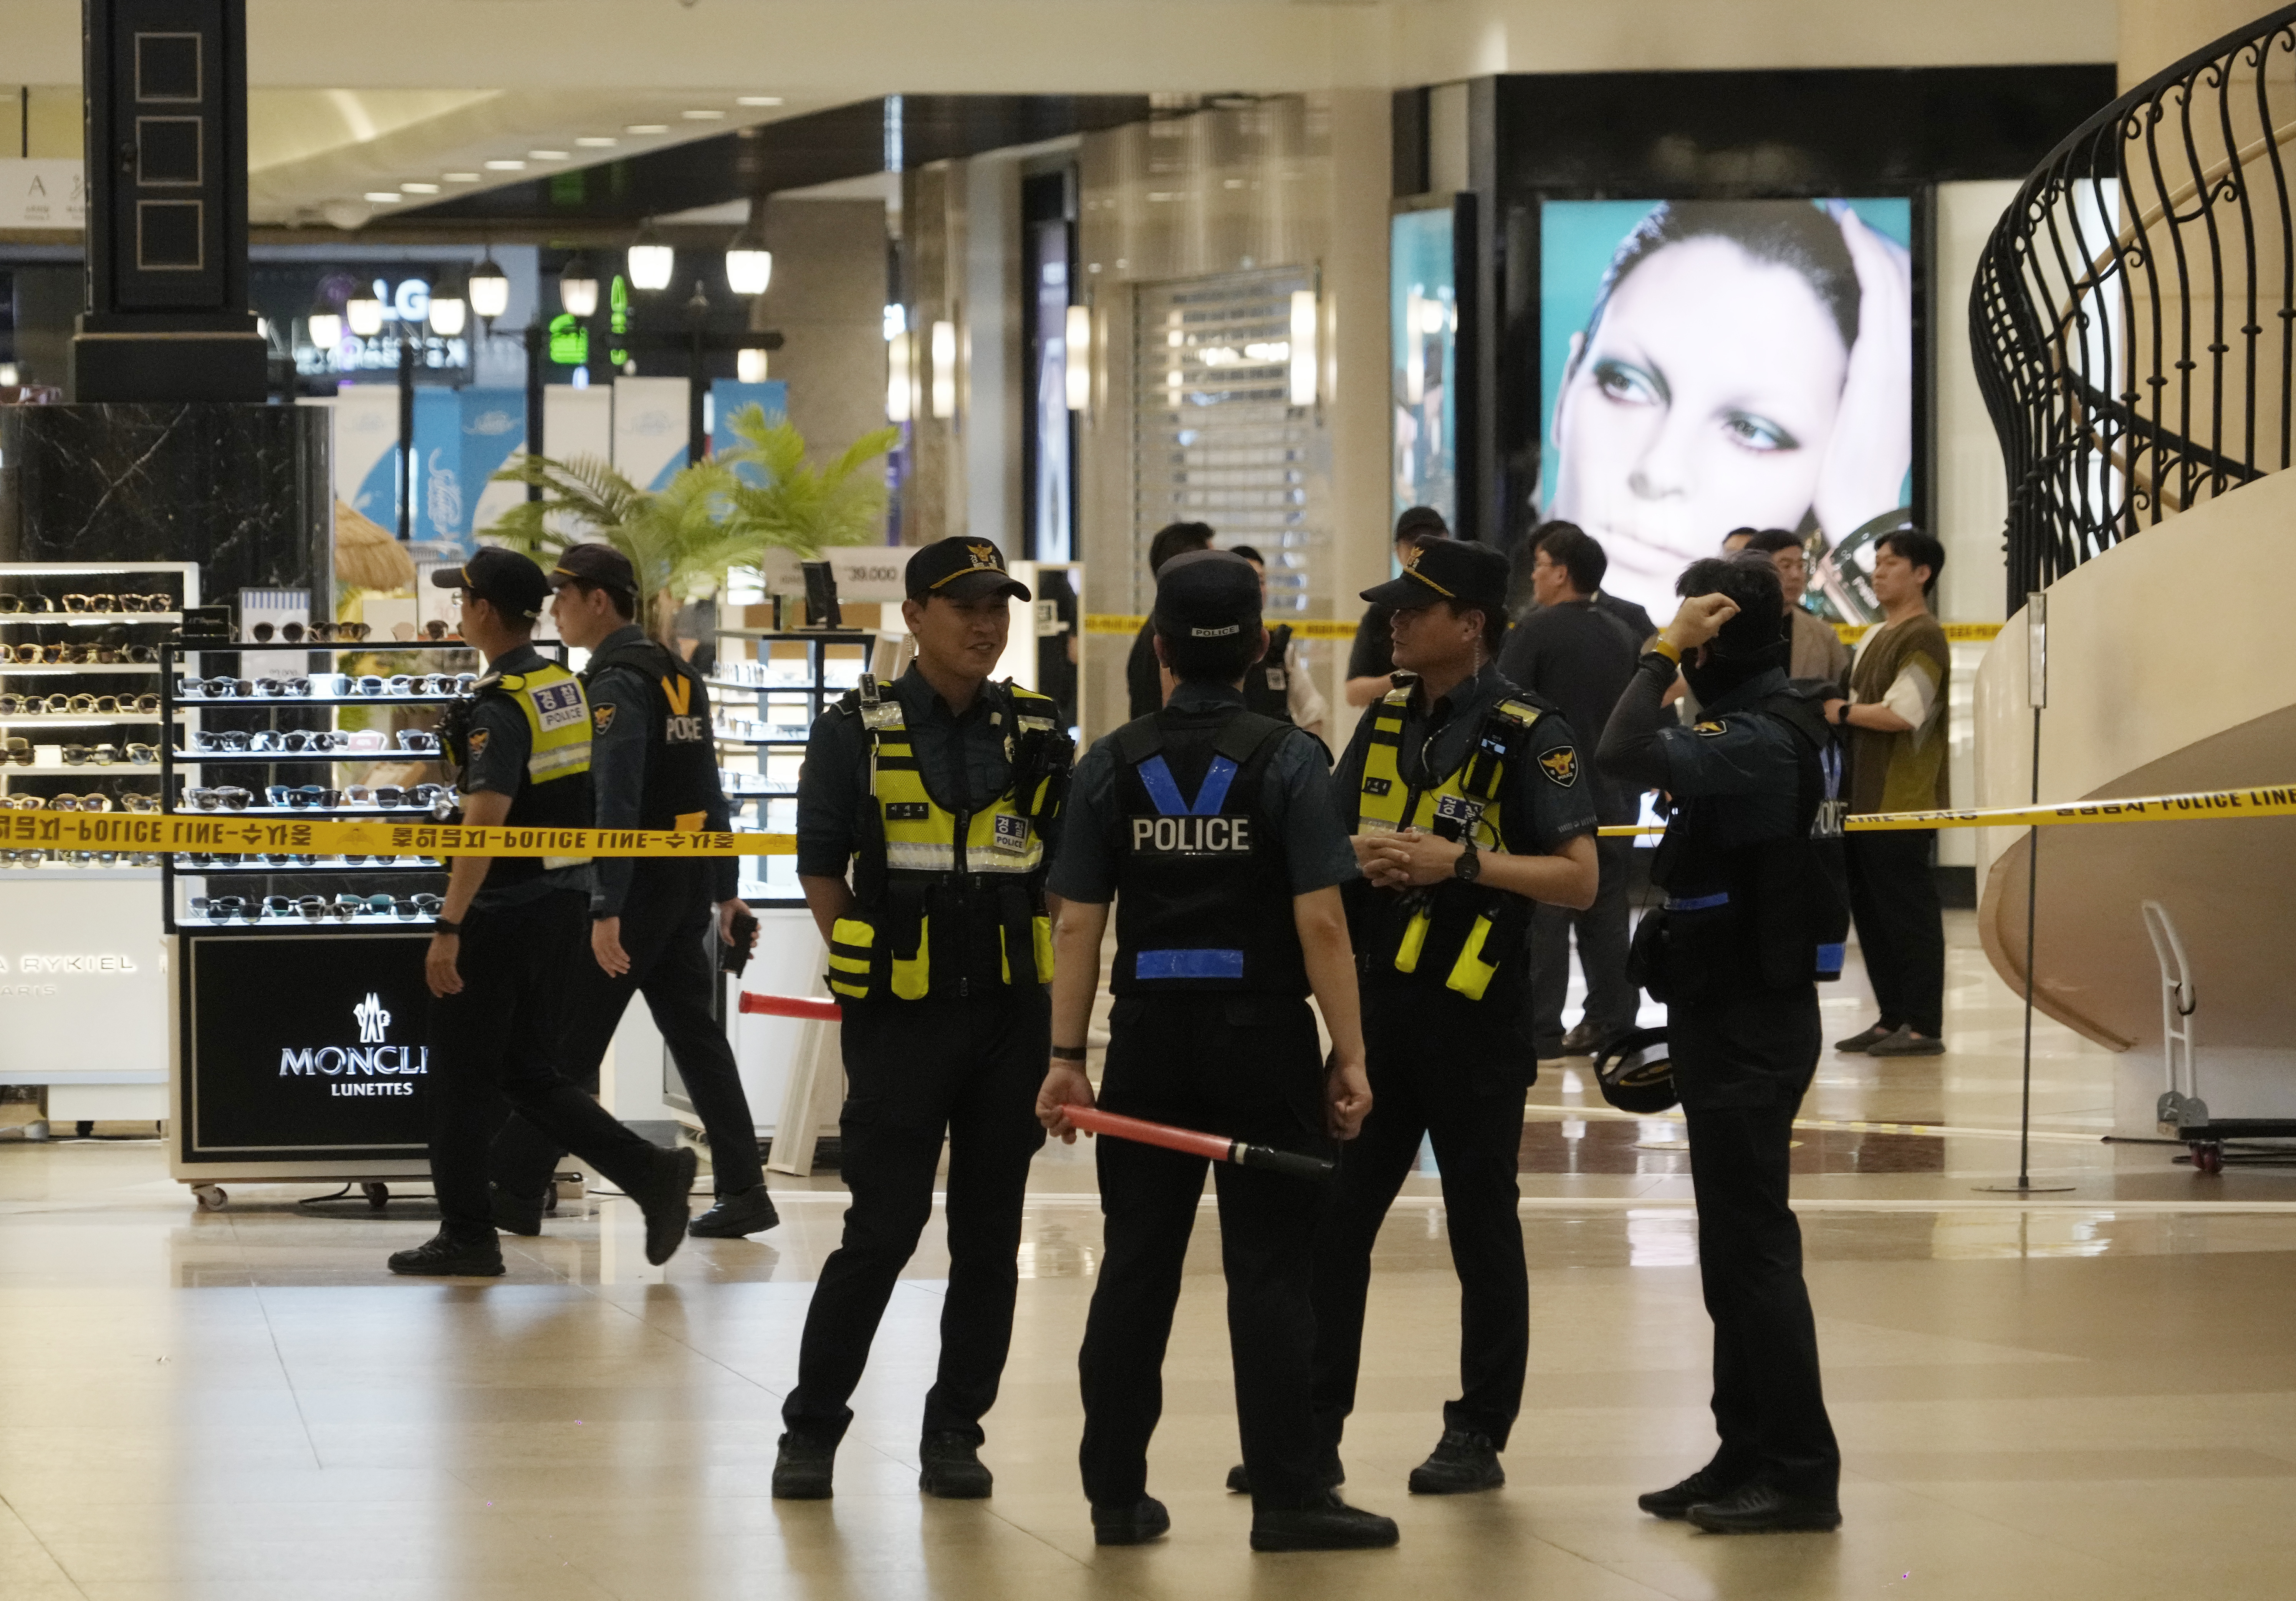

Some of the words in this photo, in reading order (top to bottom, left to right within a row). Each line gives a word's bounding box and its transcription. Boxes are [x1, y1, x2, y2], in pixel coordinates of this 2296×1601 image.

[1196, 627, 1235, 636] POLICE
[546, 708, 581, 725] POLICE
[2250, 789, 2296, 805] LINE
[1133, 818, 1250, 850] POLICE
[997, 836, 1023, 848] POLICE
[23, 956, 133, 970] RYKIEL
[331, 1082, 414, 1097] LUNETTES
